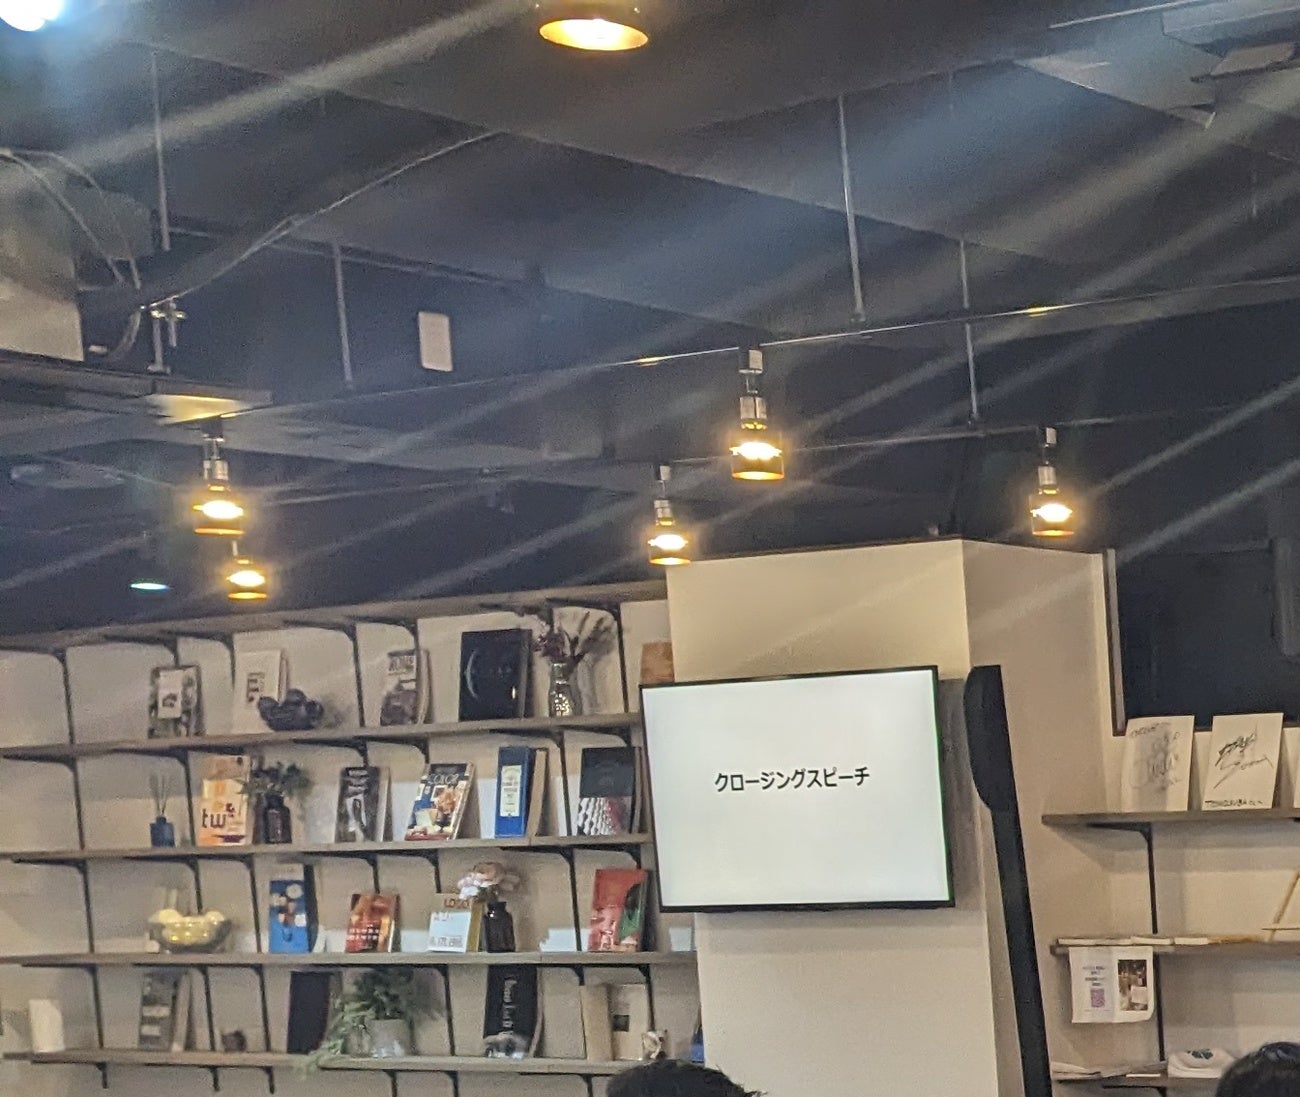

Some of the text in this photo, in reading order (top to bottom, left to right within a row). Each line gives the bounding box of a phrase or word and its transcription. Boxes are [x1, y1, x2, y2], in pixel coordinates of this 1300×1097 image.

[714, 766, 870, 792] クロージングスピーチ
